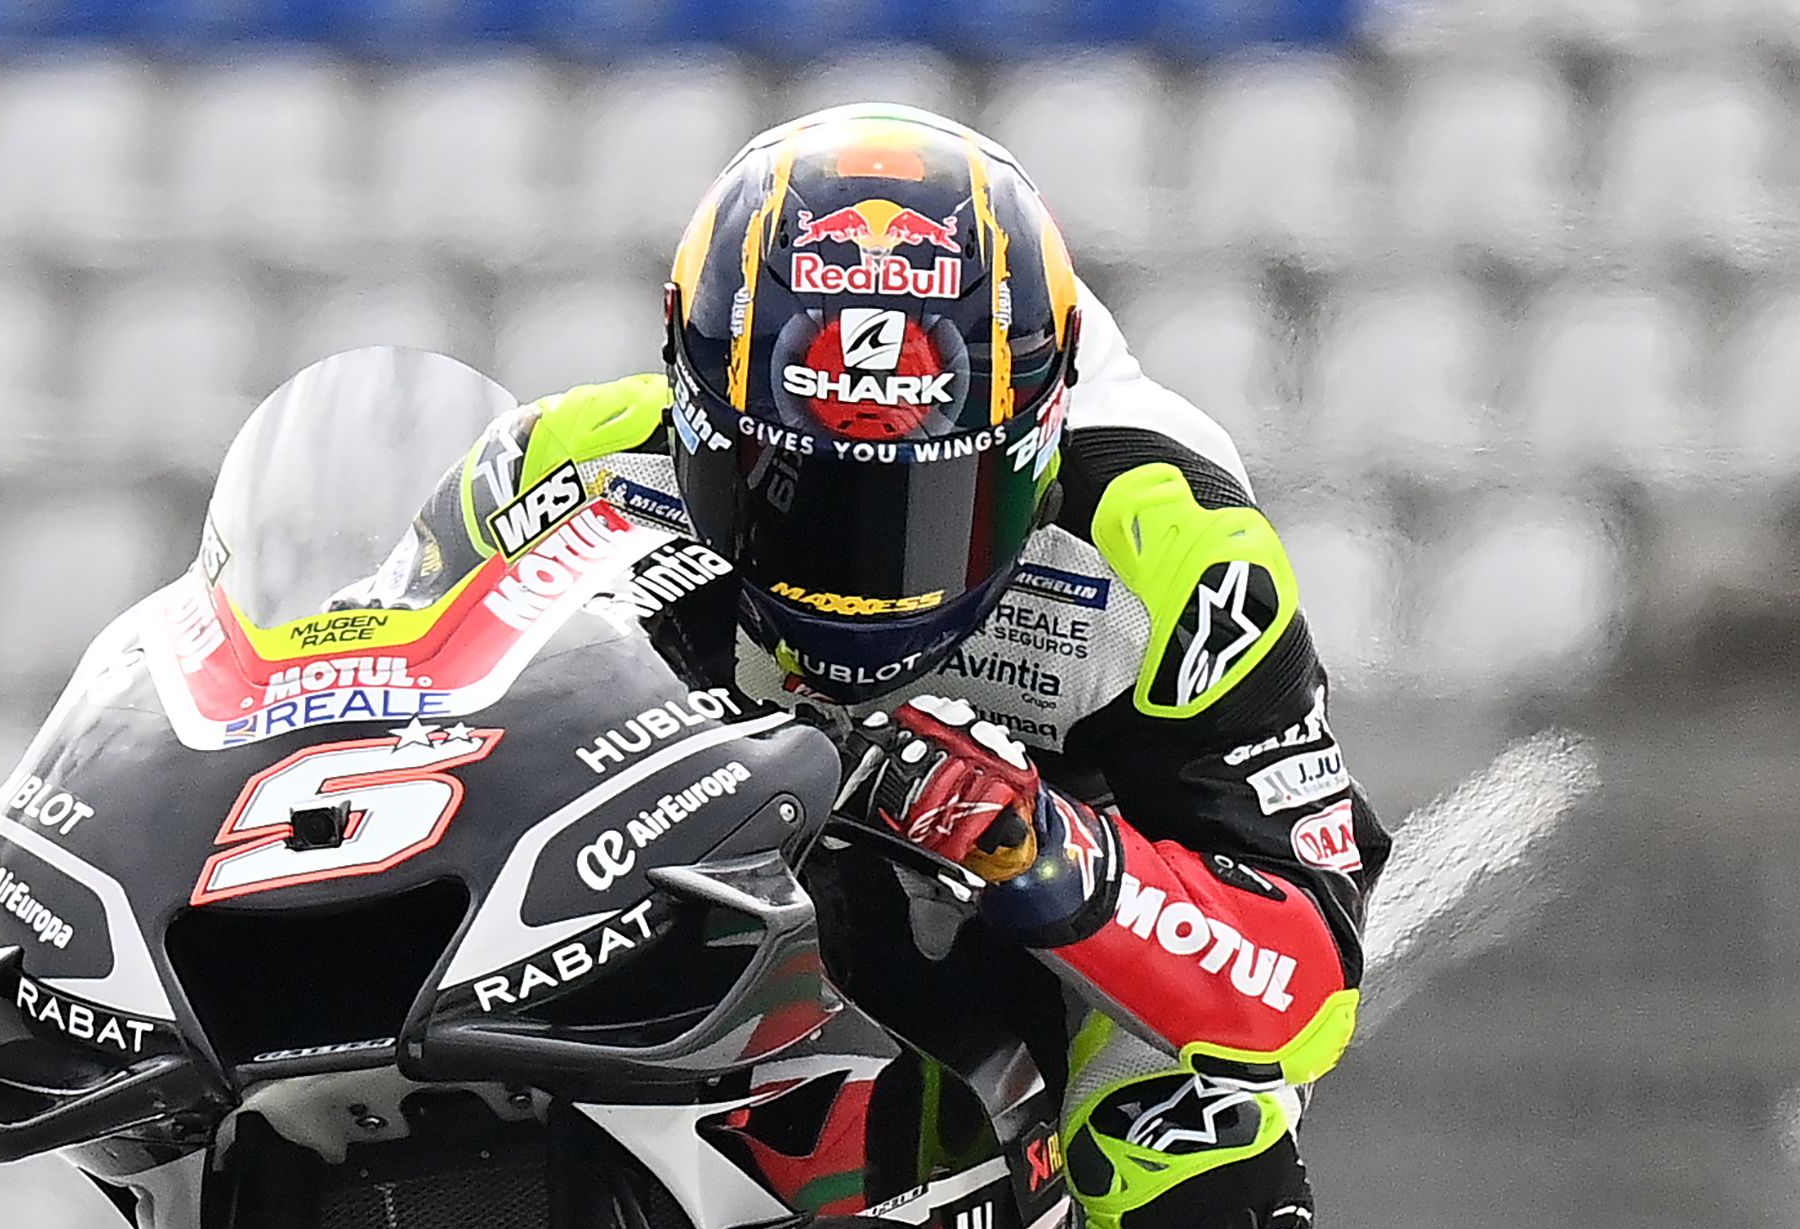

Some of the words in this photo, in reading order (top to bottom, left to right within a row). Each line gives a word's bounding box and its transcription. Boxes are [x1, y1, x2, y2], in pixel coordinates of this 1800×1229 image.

[792, 253, 875, 292] Red
[879, 256, 961, 297] Bull
[783, 364, 955, 405] SHARK
[738, 416, 815, 455] GIVES
[833, 442, 897, 464] YOU
[913, 425, 1007, 463] WINGS
[493, 464, 581, 554] WRS
[483, 508, 616, 632] MOTUL
[290, 615, 389, 640] MUGEN
[301, 628, 376, 649] RACE
[994, 626, 1089, 660] SEGUROS
[996, 604, 1091, 642] REALE
[263, 656, 415, 706] MOTUL
[936, 648, 1063, 697] Avintia
[265, 689, 452, 735] REALE
[972, 705, 1058, 742] umaq
[1021, 692, 1058, 710] Grupo
[575, 687, 743, 774] HUBLOT
[1298, 752, 1342, 784] J.JU
[10, 775, 95, 835] BLOT
[190, 728, 506, 907] 5
[627, 760, 752, 848] AirEuropa
[473, 899, 653, 1013] RABAT
[1114, 871, 1298, 1013] MOTUL
[16, 977, 154, 1054] RABAT
